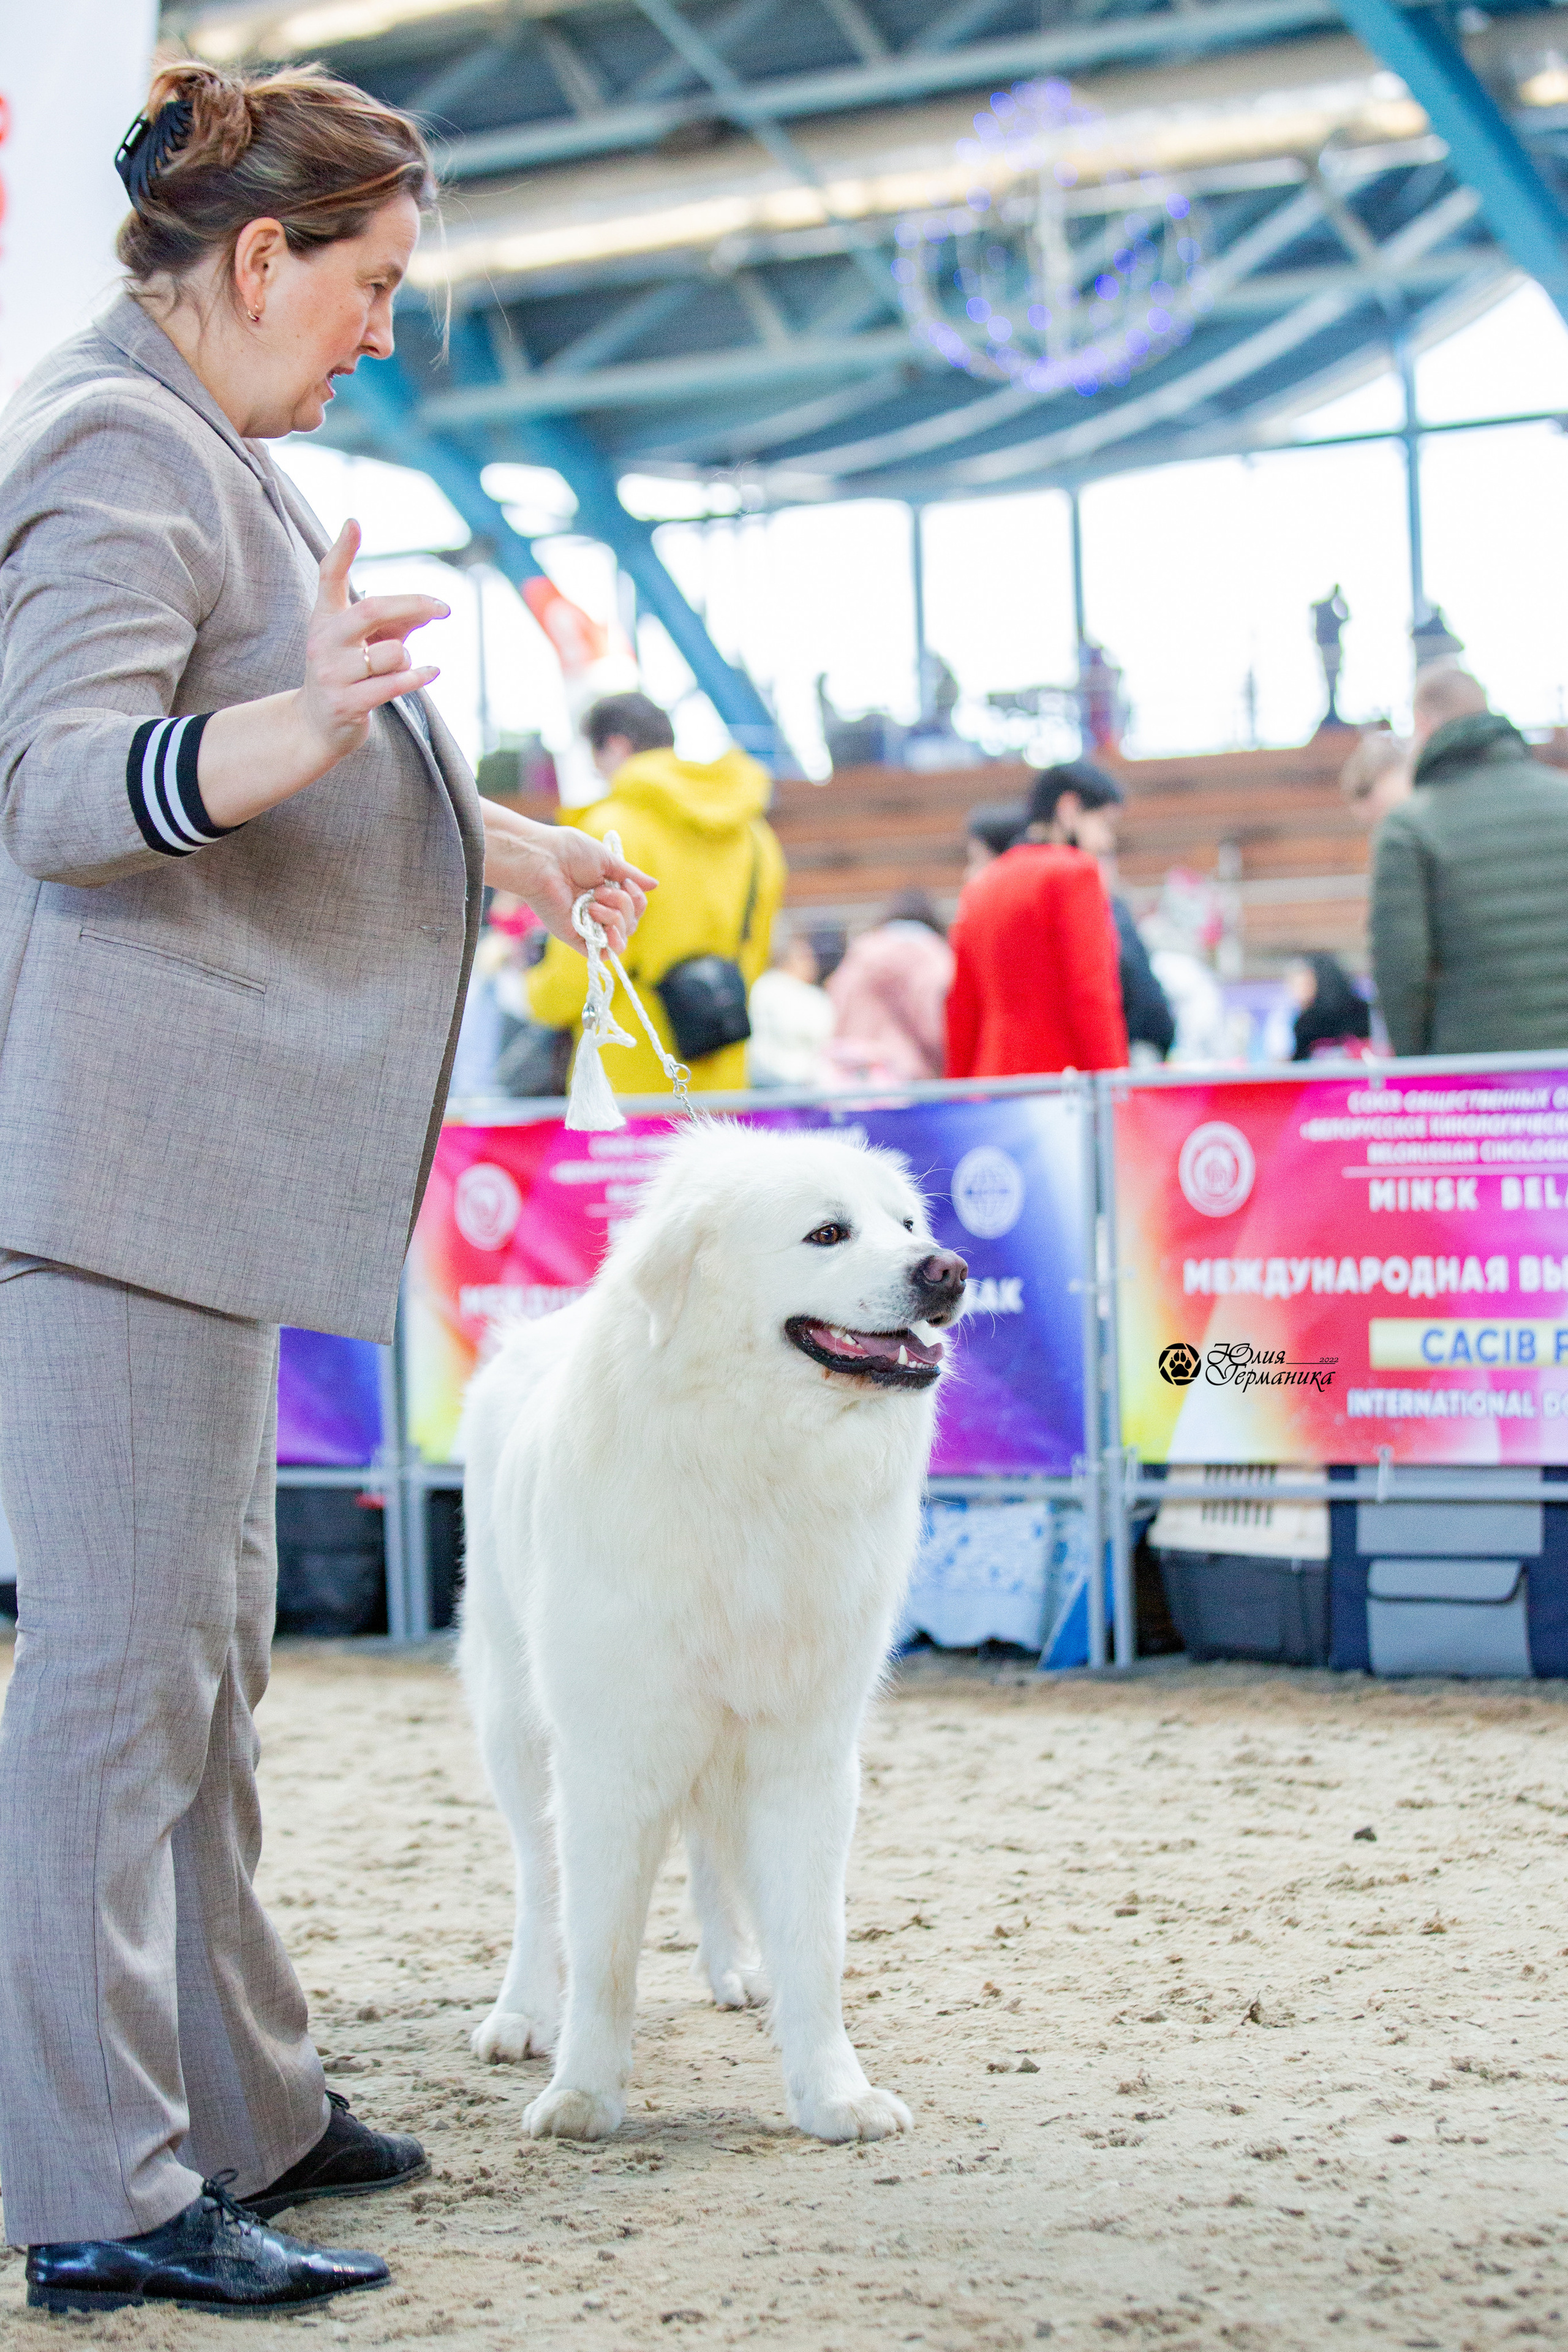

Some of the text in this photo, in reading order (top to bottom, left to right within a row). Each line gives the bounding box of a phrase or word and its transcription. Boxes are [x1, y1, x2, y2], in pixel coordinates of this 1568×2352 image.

[1370, 1176, 1568, 1212] MINSK BEL
[1184, 1256, 1509, 1299] МЕЖДУНАРОДНАЯ
[1421, 1329, 1536, 1363] CACIB
[1348, 1389, 1535, 1418] INTERNATIONAL
